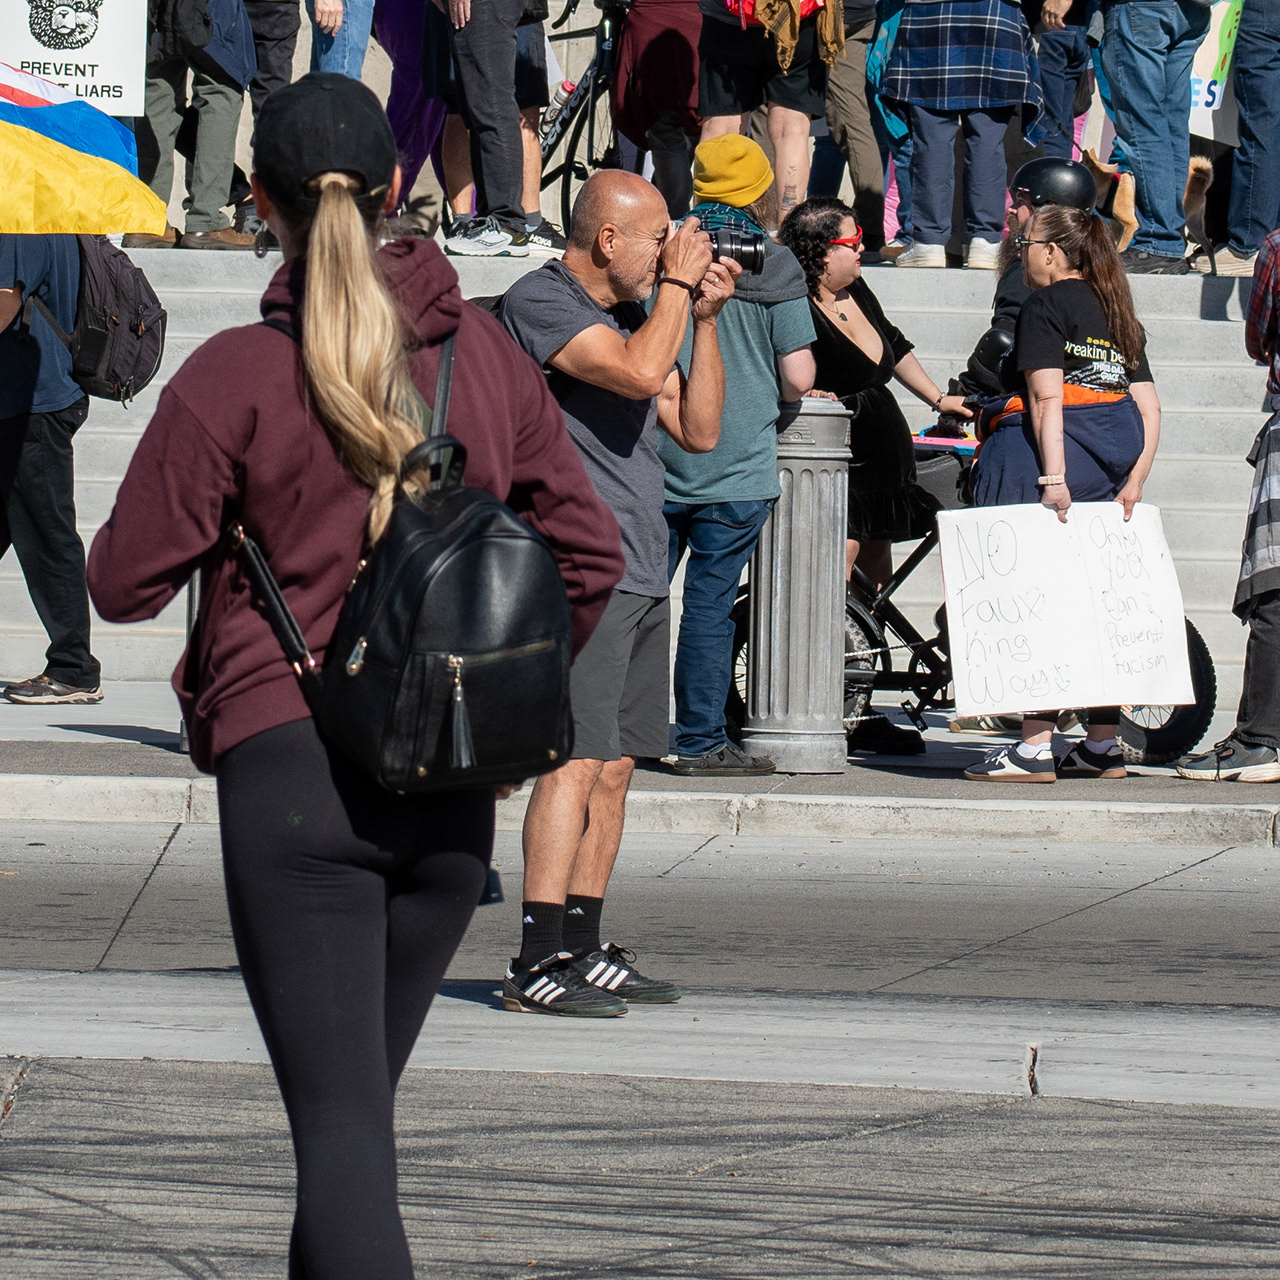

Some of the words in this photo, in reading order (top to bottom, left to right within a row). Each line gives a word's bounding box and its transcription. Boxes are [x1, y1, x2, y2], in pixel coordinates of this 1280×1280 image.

[20, 61, 99, 78] PREVENT
[74, 84, 124, 99] LIARS
[529, 233, 553, 248] HOKA
[954, 520, 1018, 582] NO
